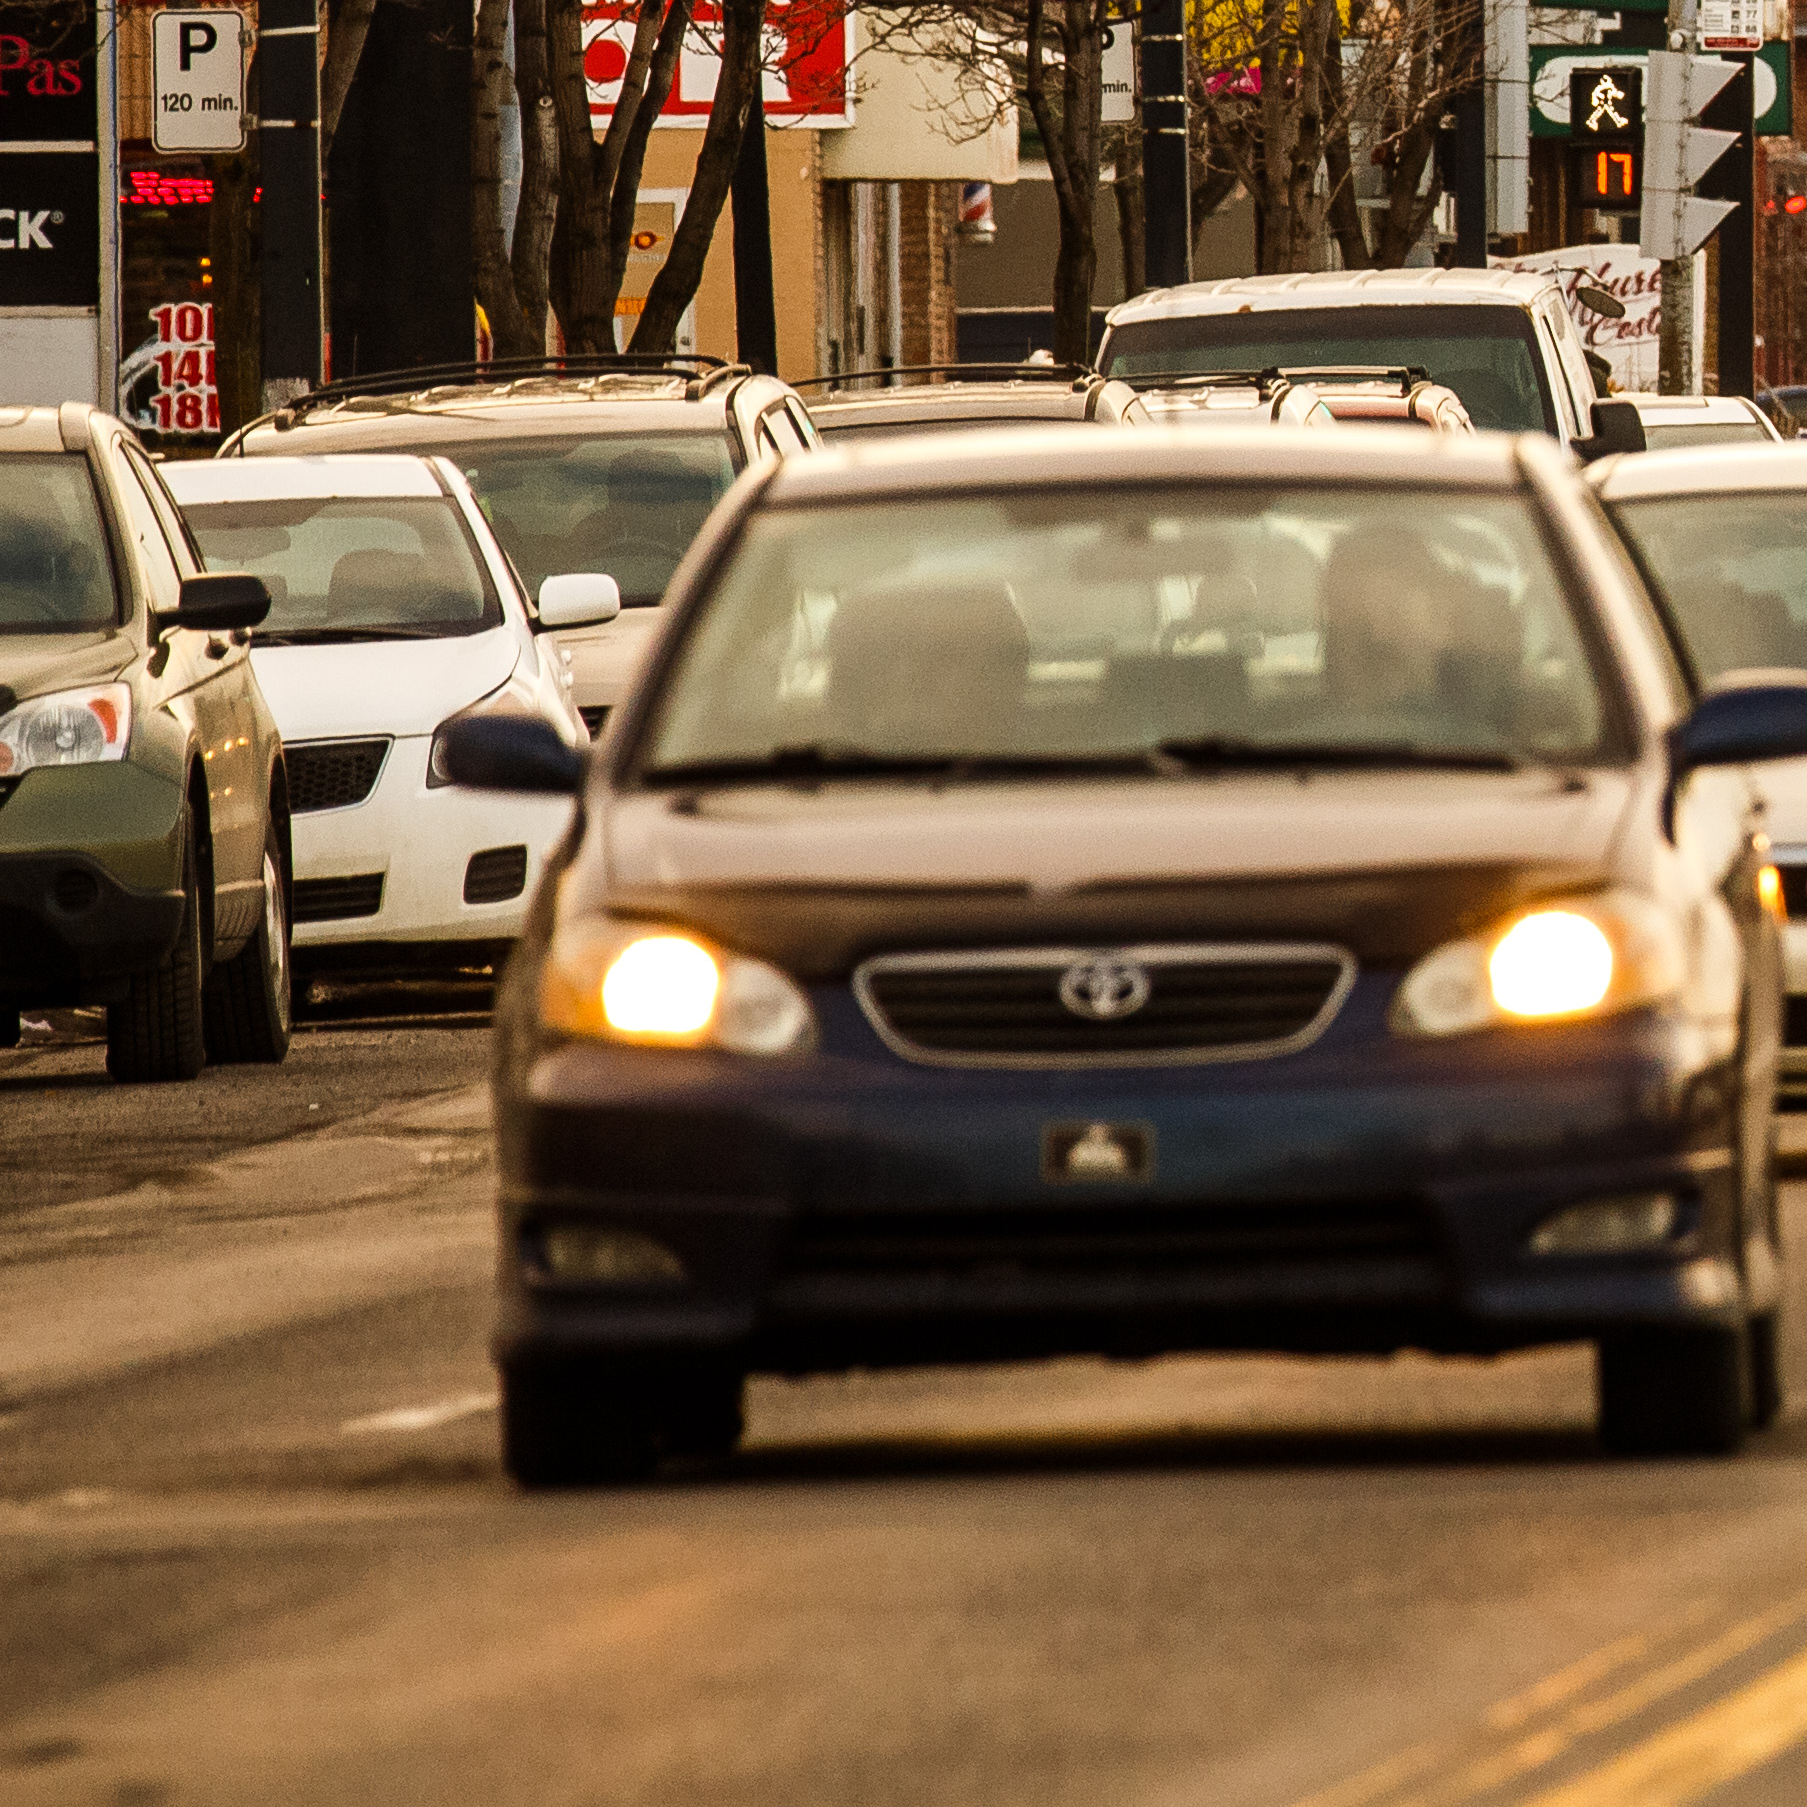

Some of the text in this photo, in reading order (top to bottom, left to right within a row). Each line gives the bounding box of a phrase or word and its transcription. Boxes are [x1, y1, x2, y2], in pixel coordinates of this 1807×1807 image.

[179, 22, 217, 71] P
[161, 93, 239, 112] 120 min.
[1597, 151, 1633, 195] 17
